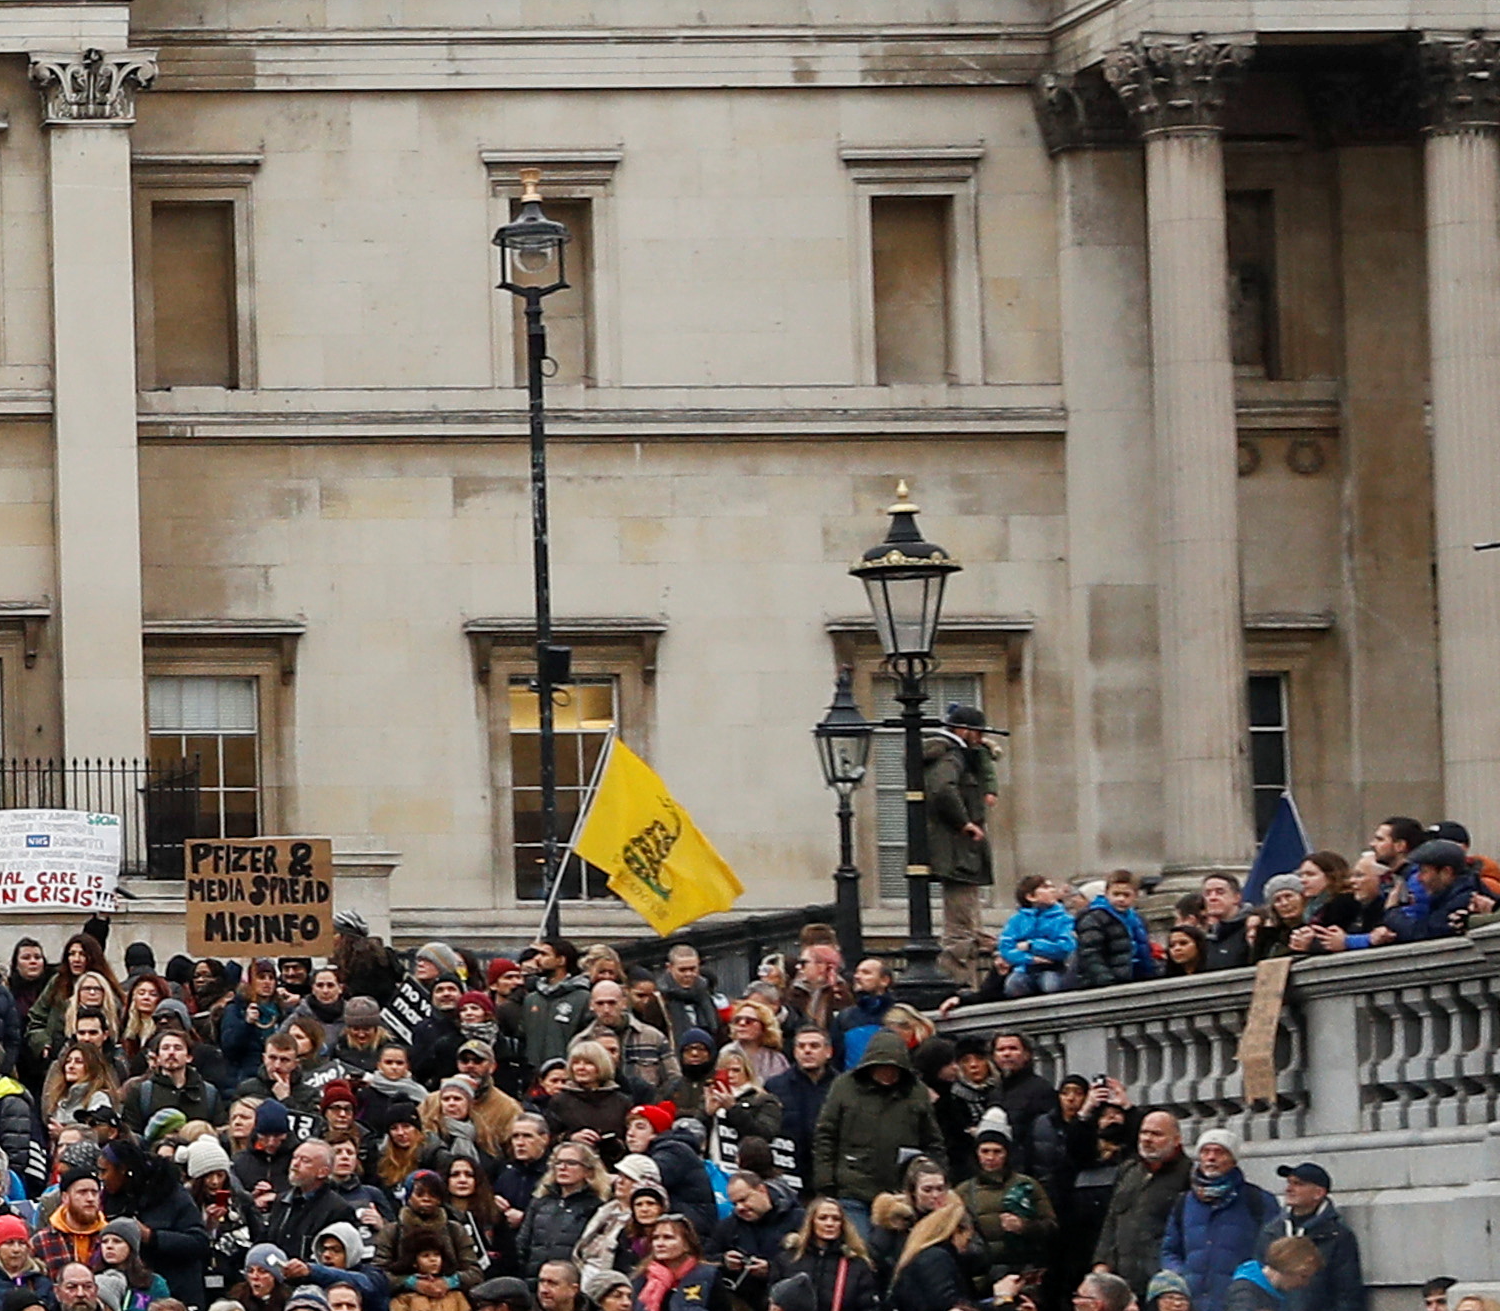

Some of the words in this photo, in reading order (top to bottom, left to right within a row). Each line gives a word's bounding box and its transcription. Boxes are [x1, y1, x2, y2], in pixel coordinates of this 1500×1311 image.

[191, 843, 278, 874] PFIZER
[289, 842, 313, 878] &
[36, 872, 77, 886] CARE
[87, 875, 104, 888] IS
[188, 877, 245, 902] MEDIA
[249, 875, 330, 905] SPREAD
[204, 911, 320, 944] MISINFO
